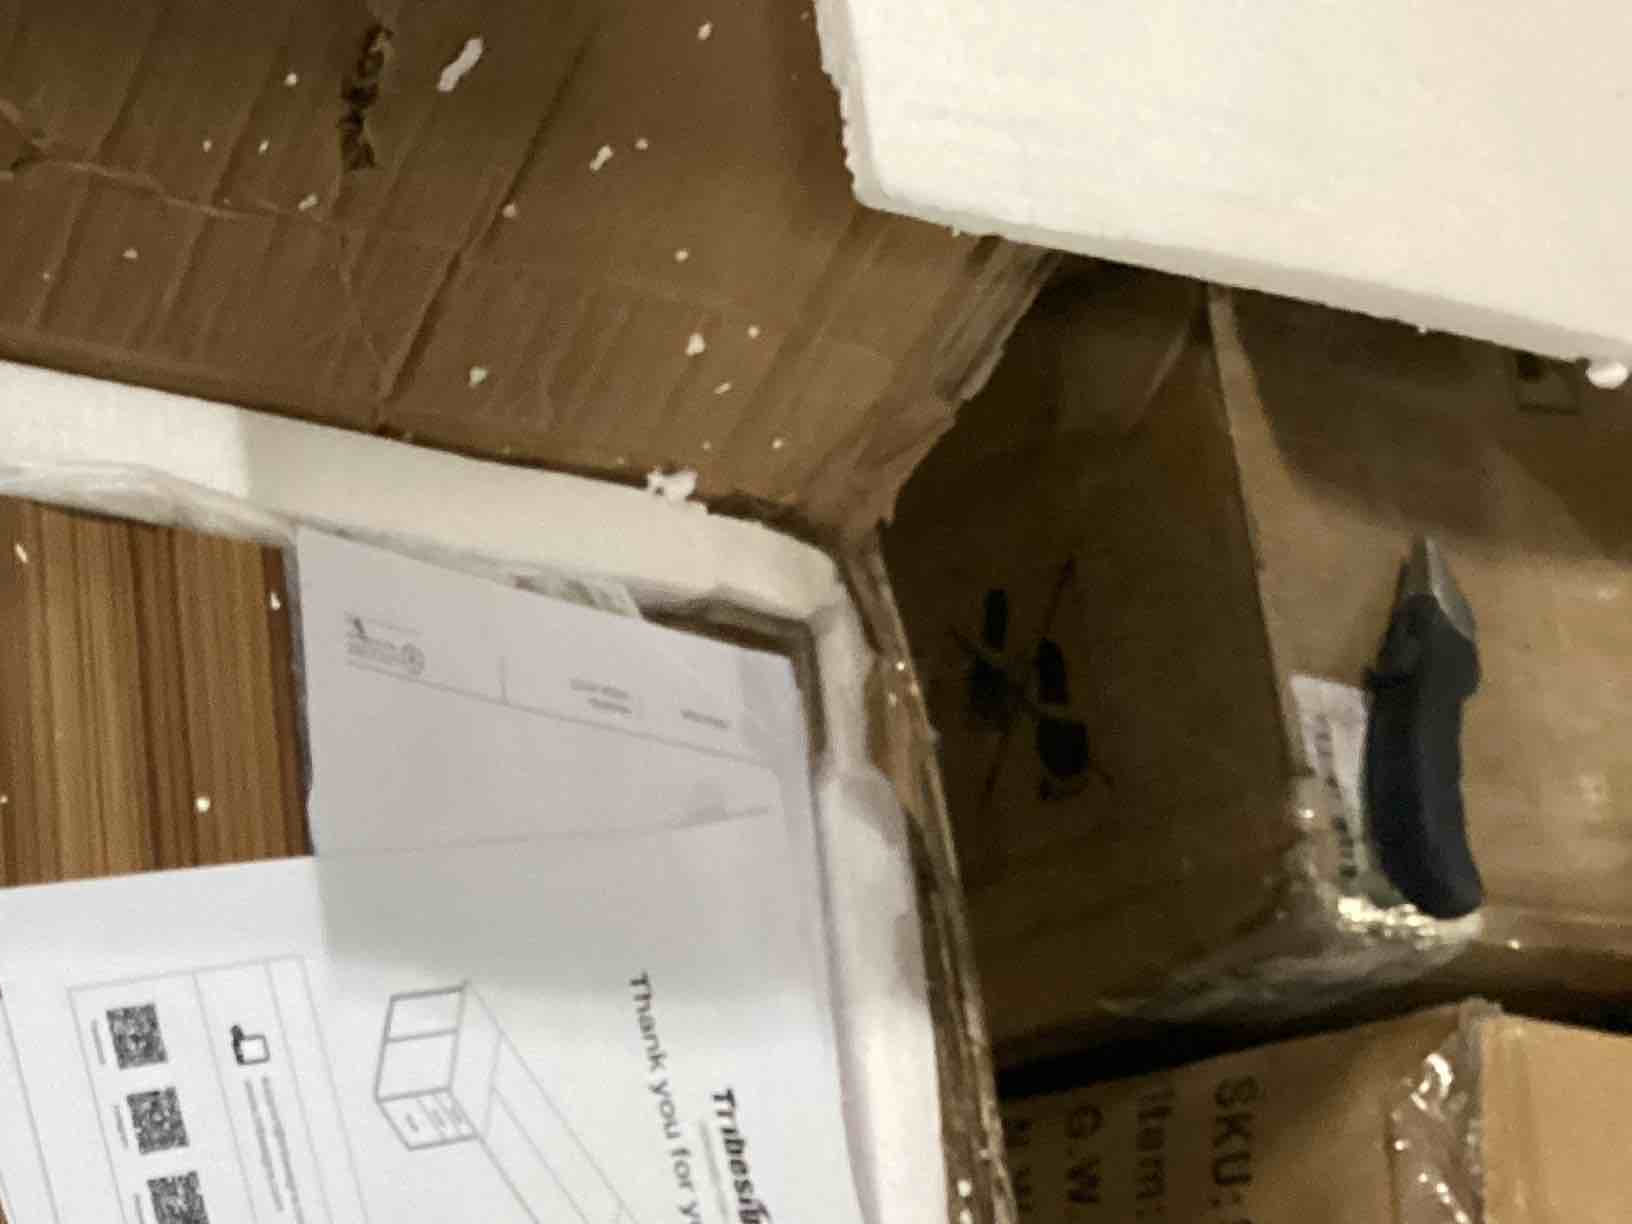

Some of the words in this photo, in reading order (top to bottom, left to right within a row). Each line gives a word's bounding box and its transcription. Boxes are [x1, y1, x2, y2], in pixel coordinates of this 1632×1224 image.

[629, 971, 667, 1072] Thank
[649, 1078, 682, 1139] you
[671, 1148, 694, 1193] for
